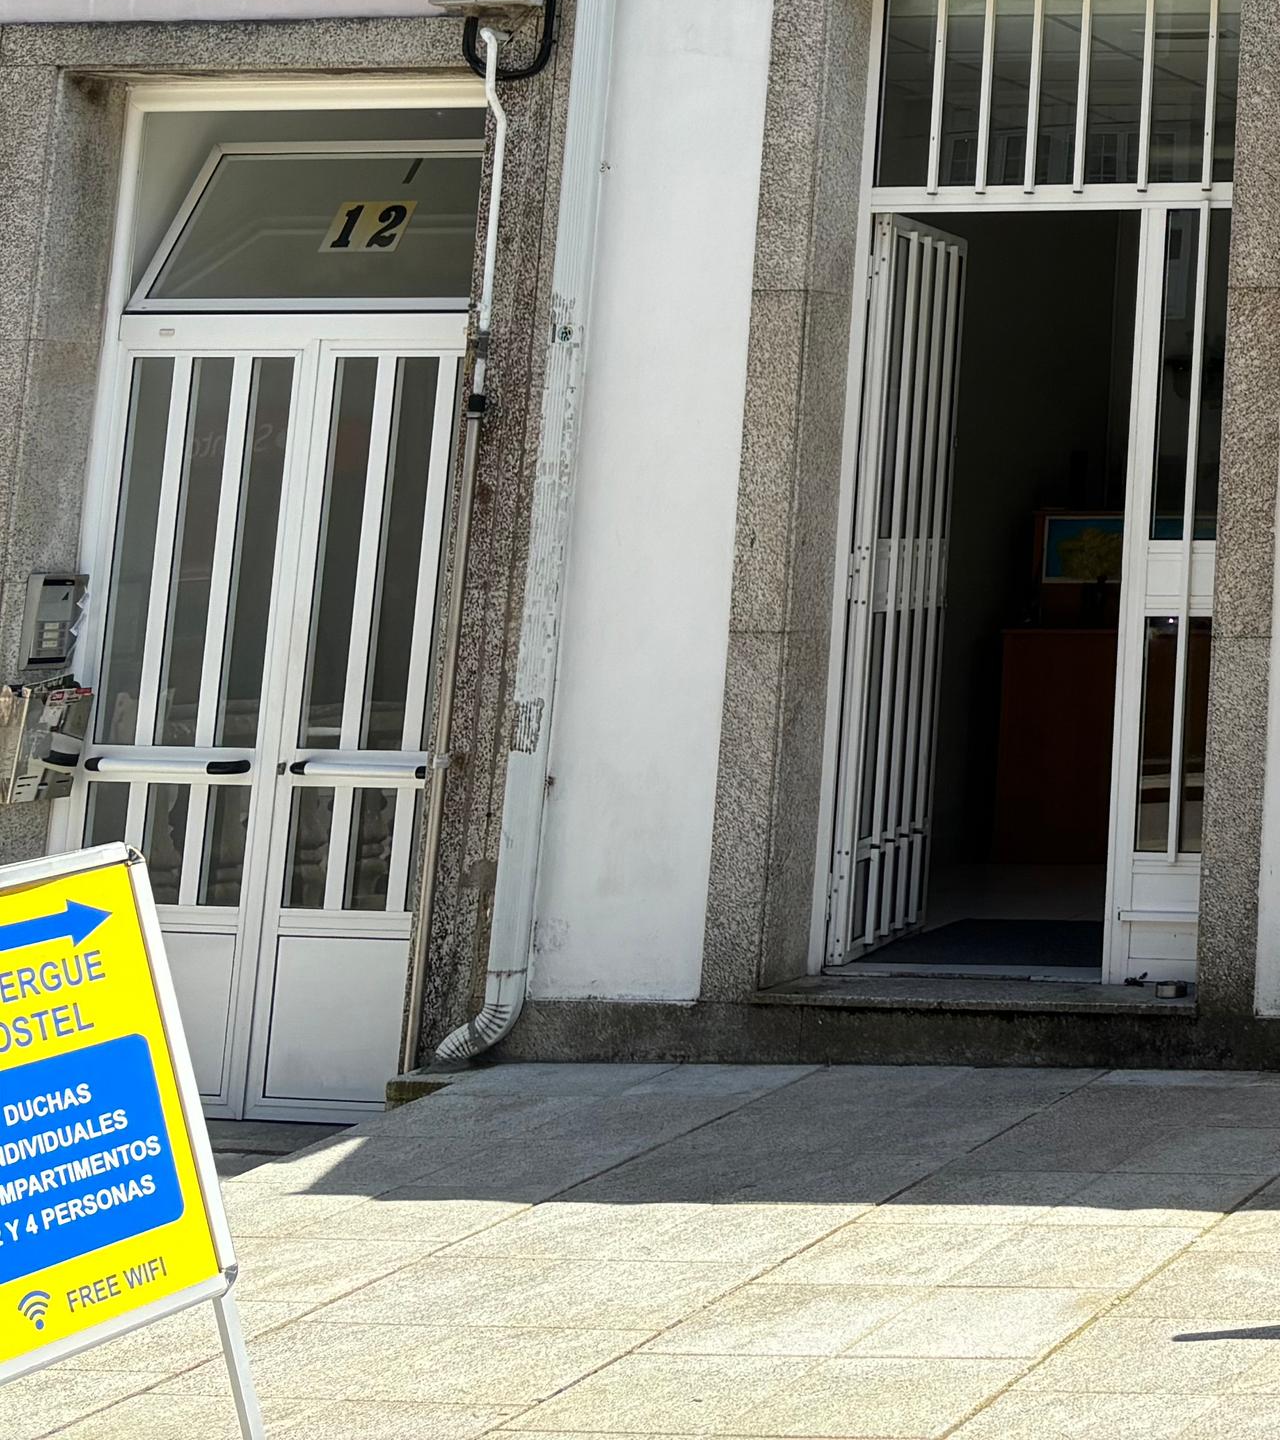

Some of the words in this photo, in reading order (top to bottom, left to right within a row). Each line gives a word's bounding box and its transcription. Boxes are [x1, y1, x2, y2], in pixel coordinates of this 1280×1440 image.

[330, 204, 407, 249] 12
[0, 950, 105, 1003] ERGUE
[3, 1083, 92, 1127] DUCHAS
[4, 1219, 19, 1242] Y
[26, 1213, 38, 1234] 4
[41, 1174, 156, 1230] PERSONAS
[66, 1274, 122, 1312] FREE
[123, 1256, 167, 1289] WIFI
